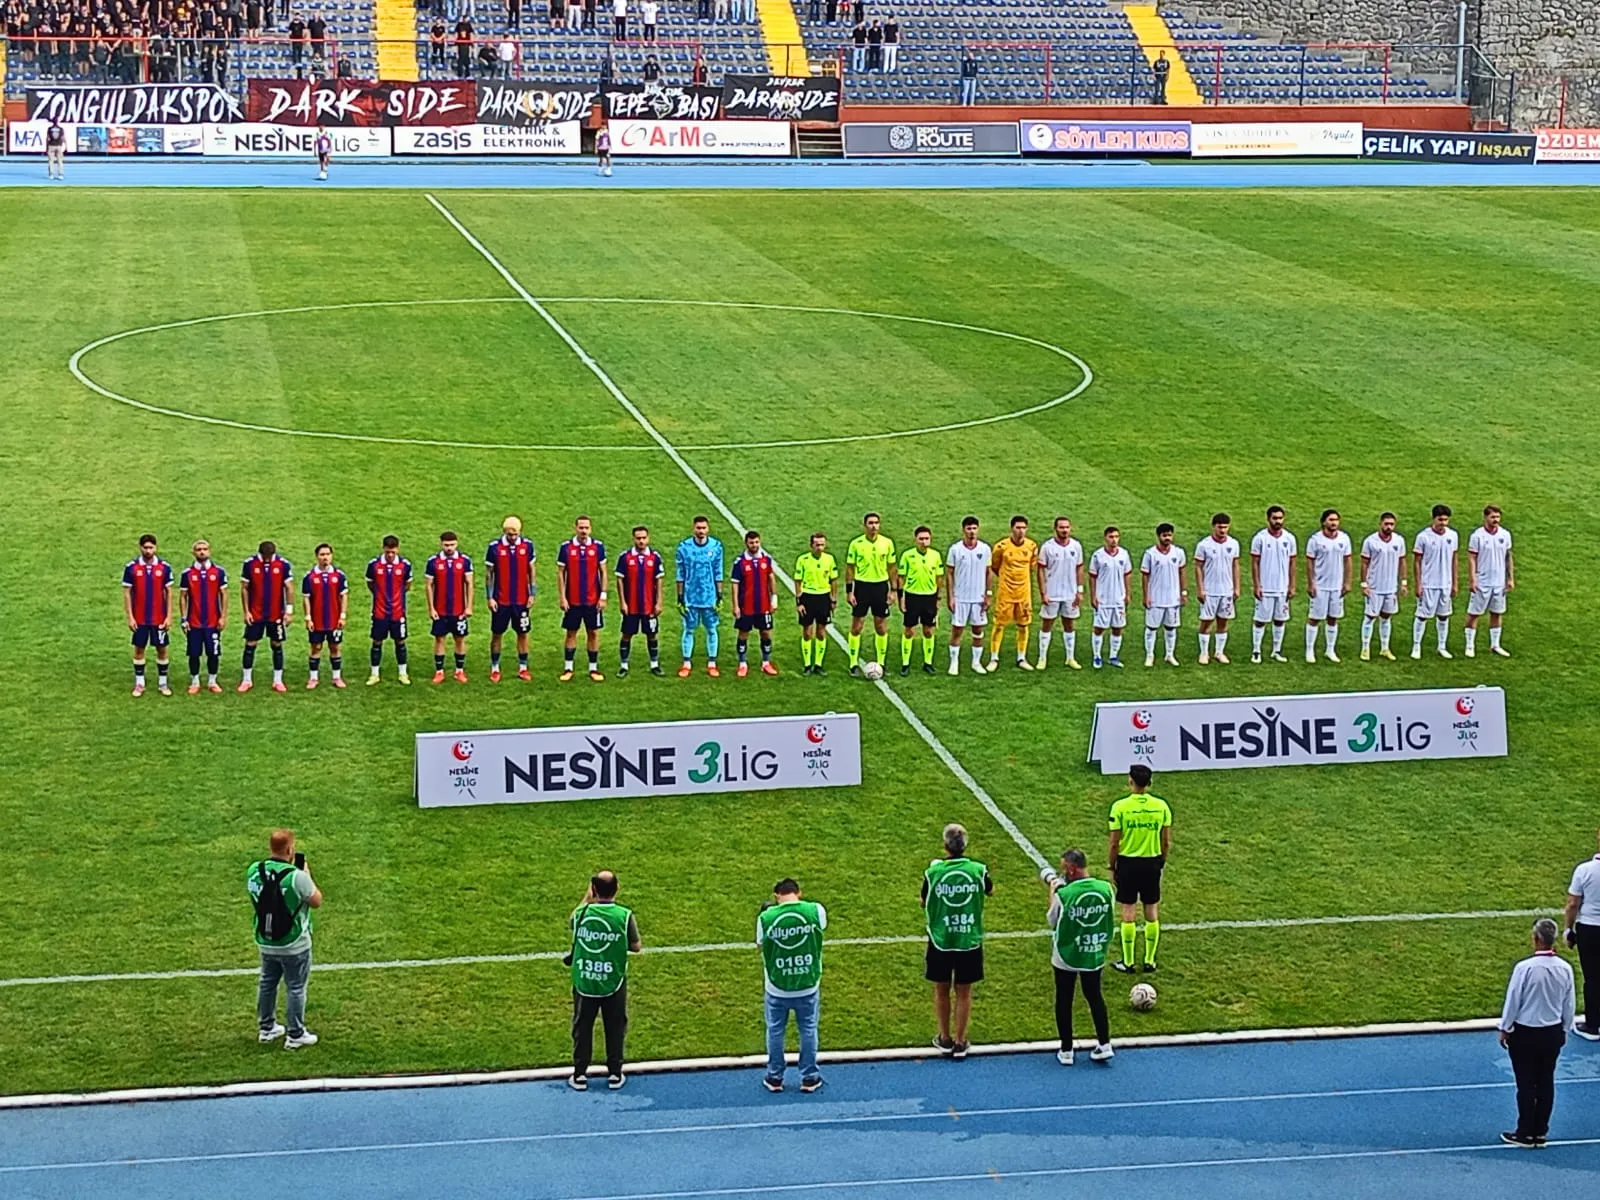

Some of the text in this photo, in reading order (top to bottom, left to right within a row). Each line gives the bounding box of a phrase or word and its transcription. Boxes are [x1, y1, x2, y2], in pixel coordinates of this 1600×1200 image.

[260, 85, 467, 123] DARK SIDE
[477, 85, 597, 120] DARK SIDE
[605, 91, 649, 117] TEPE
[650, 126, 717, 147] ArMe
[916, 132, 974, 146] ROUTE
[1055, 126, 1188, 149] SÖYLEM KURS
[1364, 135, 1531, 158] ÇELİK YAPI İNŞAAT
[943, 913, 975, 926] 1384
[1074, 933, 1107, 946] 1382
[576, 958, 613, 973] 1386
[776, 954, 813, 968] 0169
